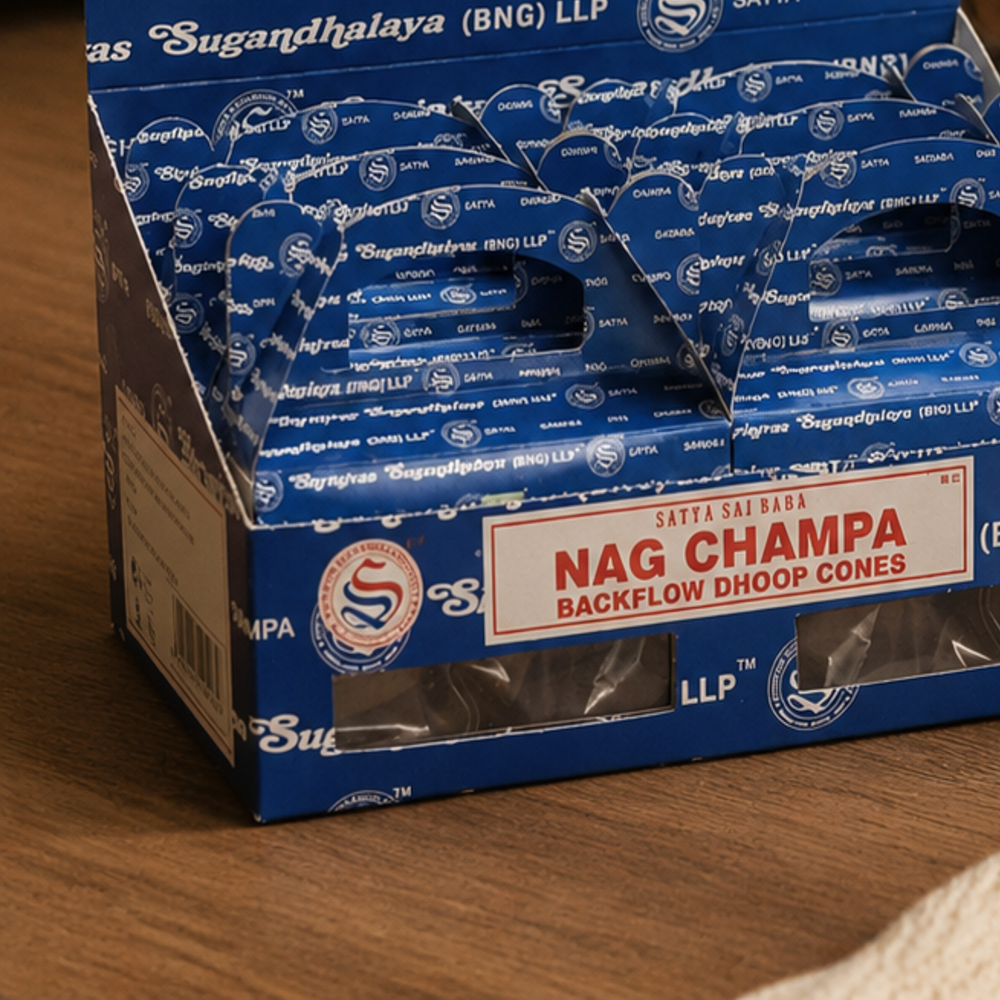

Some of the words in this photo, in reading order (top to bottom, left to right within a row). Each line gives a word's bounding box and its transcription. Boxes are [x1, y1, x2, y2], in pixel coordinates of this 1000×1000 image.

[149, 13, 445, 58] Sugandhalaya
[463, 2, 544, 36] (BNG)
[523, 234, 549, 248] LLP
[656, 505, 713, 528] SATYA
[722, 500, 752, 520] SAI
[761, 493, 806, 515] BABA
[555, 538, 665, 591] NAG
[685, 508, 907, 573] CHAMPA
[557, 579, 704, 619] BACKFLOW
[714, 562, 808, 599] DHOOP
[816, 552, 906, 584] CONES
[682, 674, 735, 705] LLP
